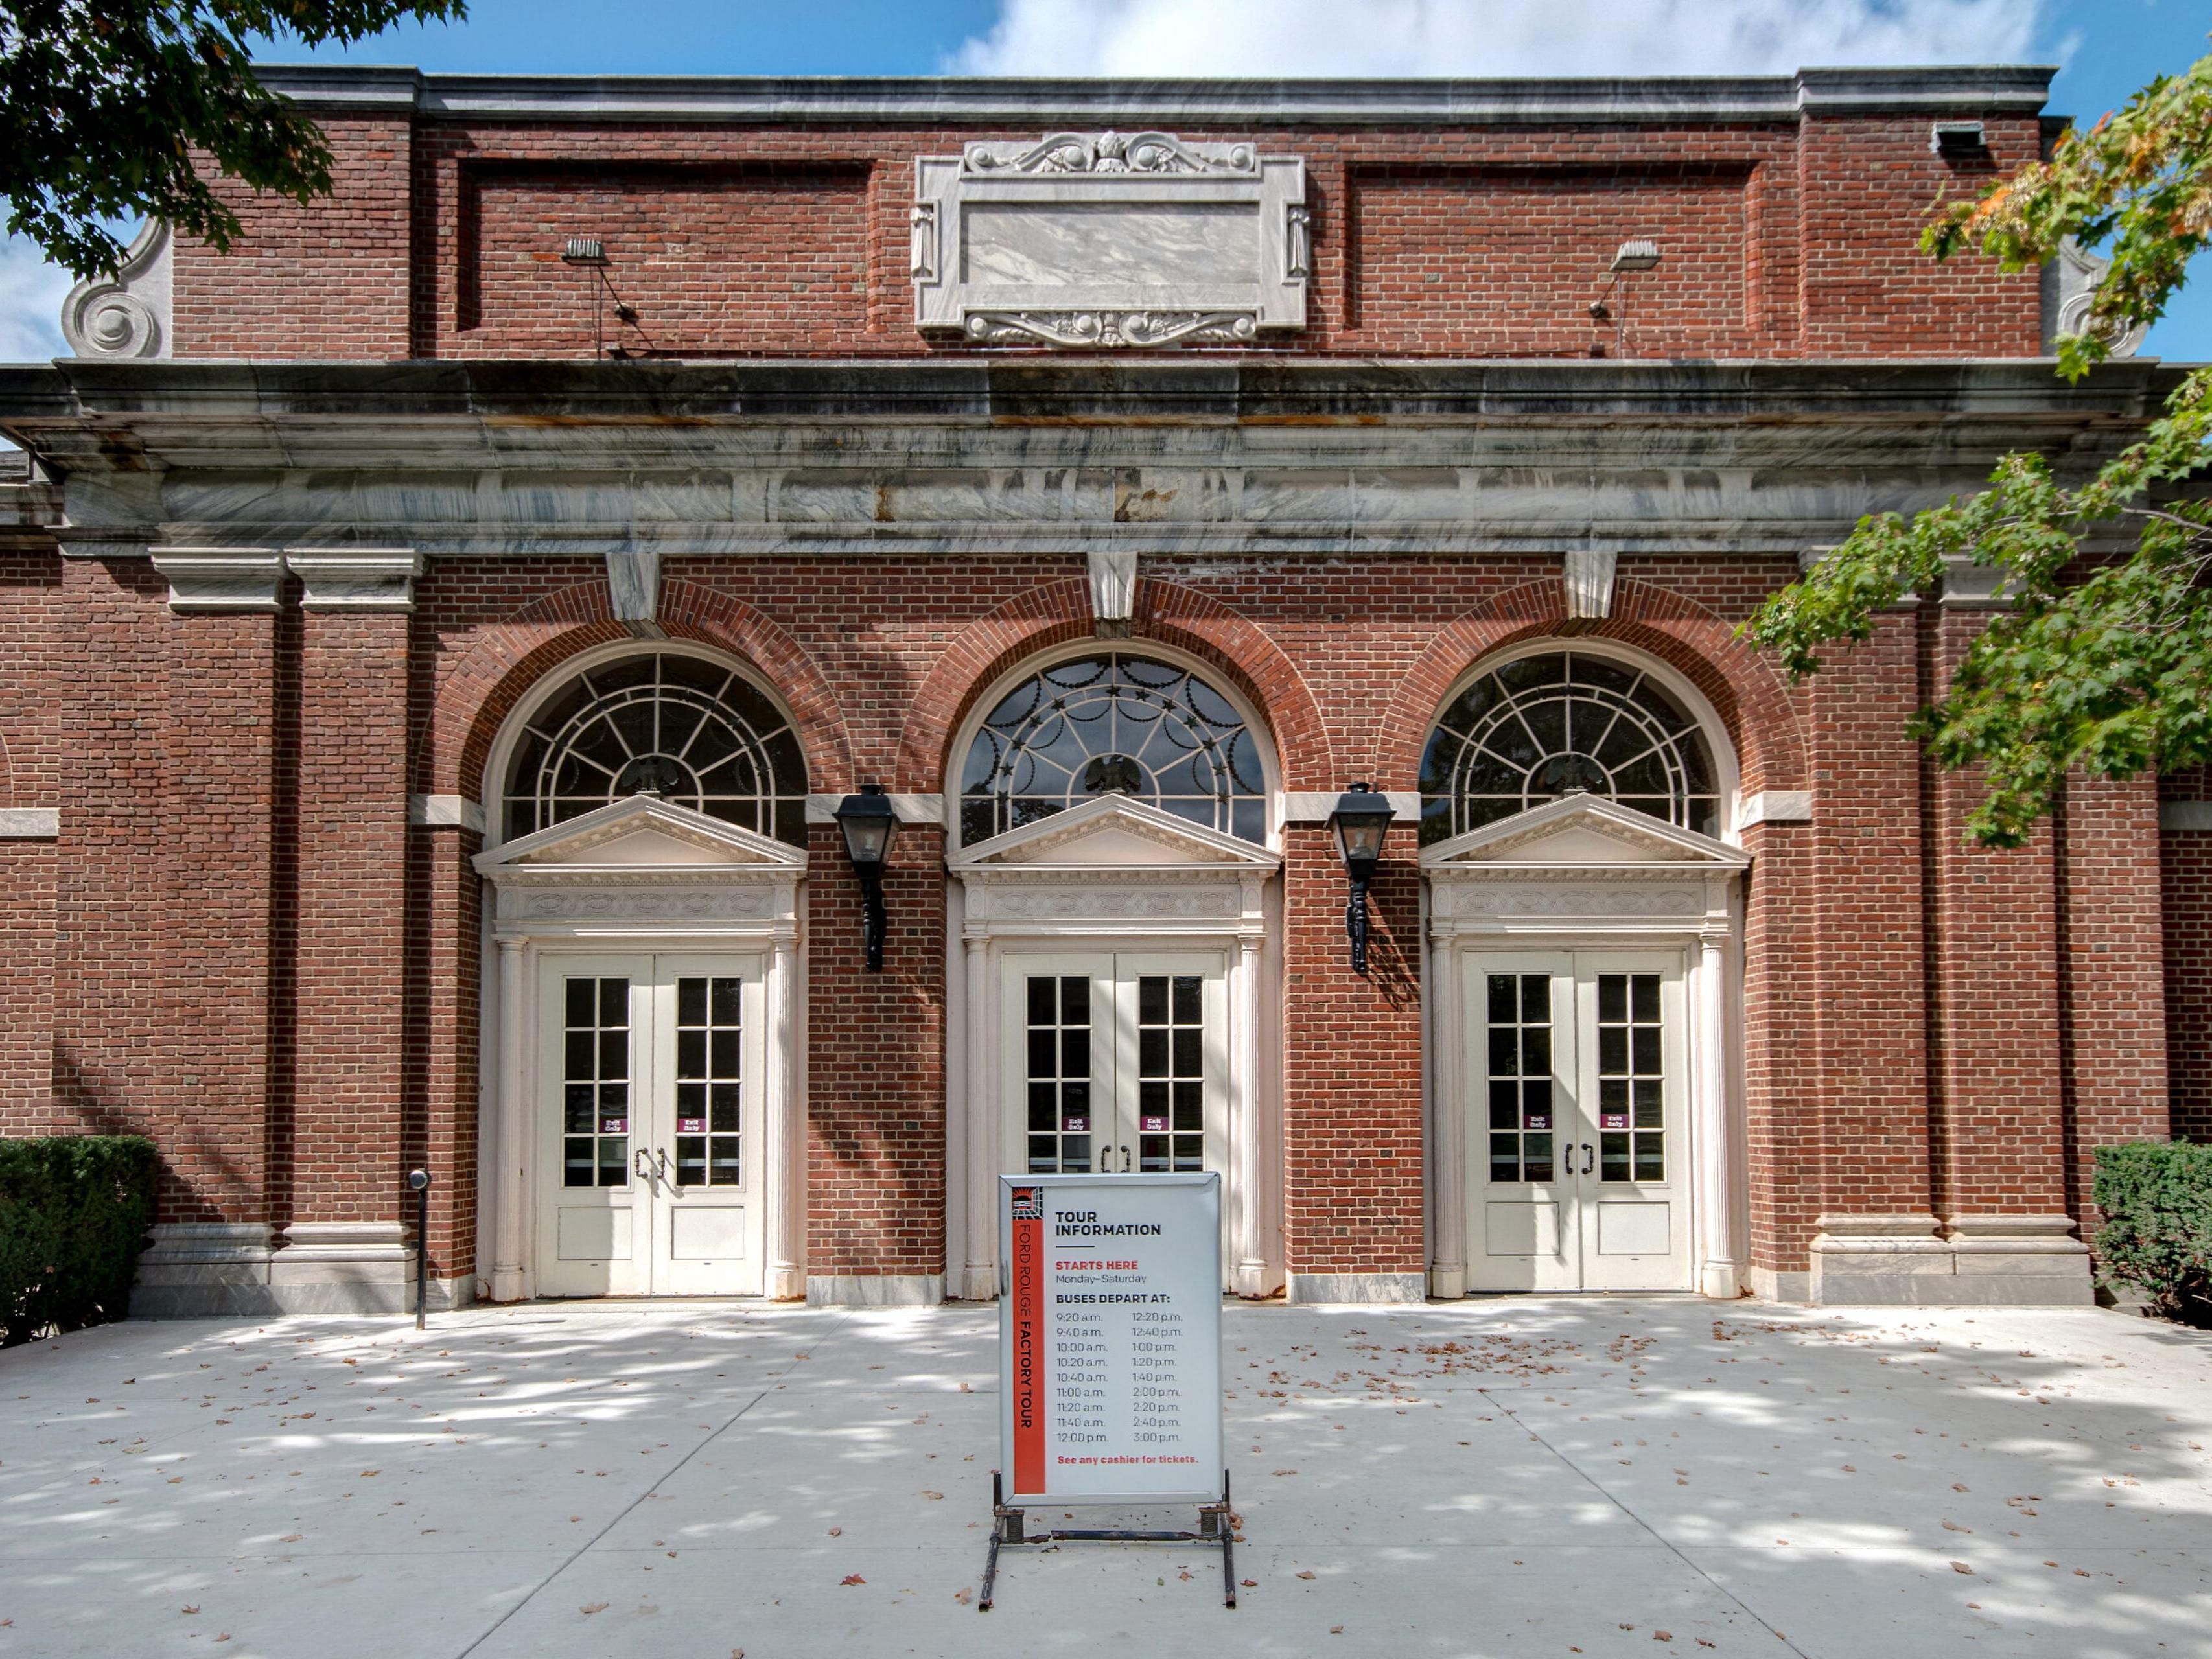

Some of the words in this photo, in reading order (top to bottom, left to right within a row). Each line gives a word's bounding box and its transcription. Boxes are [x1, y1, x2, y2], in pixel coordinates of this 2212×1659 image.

[1056, 1212, 1097, 1222] TOUR
[1056, 1225, 1161, 1236] INFORMATION
[1019, 1224, 1030, 1264] FORD
[1056, 1261, 1103, 1270] STARTS
[1107, 1261, 1137, 1270] HERE
[1019, 1267, 1031, 1316] ROUGE
[1056, 1295, 1095, 1303] BUSES
[1099, 1294, 1148, 1303] DEPART
[1151, 1294, 1170, 1303] AT:
[1057, 1313, 1079, 1321] 9:20
[1132, 1312, 1159, 1321] 12:20
[1057, 1328, 1080, 1337] 9:40
[1132, 1328, 1159, 1336] 12:40
[1161, 1329, 1182, 1338] p.m.
[1057, 1343, 1084, 1352] 10:00
[1132, 1343, 1152, 1351] 1:00
[1021, 1322, 1032, 1386] FACTORY
[1057, 1358, 1084, 1367] 10:20
[1132, 1358, 1152, 1366] 1:20
[1155, 1360, 1176, 1368] p.m.
[1057, 1373, 1084, 1382] 10:40
[1133, 1373, 1153, 1381] 1:40
[1155, 1375, 1176, 1383] p.m.
[1057, 1388, 1081, 1397] 11:00
[1133, 1387, 1156, 1396] 2:00
[1158, 1389, 1180, 1398] p.m.
[1021, 1391, 1032, 1428] TOUR
[1058, 1403, 1080, 1411] 11:20
[1134, 1402, 1156, 1411] 2:20
[1058, 1418, 1081, 1426] 11:40
[1134, 1417, 1156, 1426] 2:40
[1058, 1433, 1084, 1442] 12:00
[1134, 1433, 1157, 1441] 3:00
[1159, 1435, 1180, 1443] p.m.
